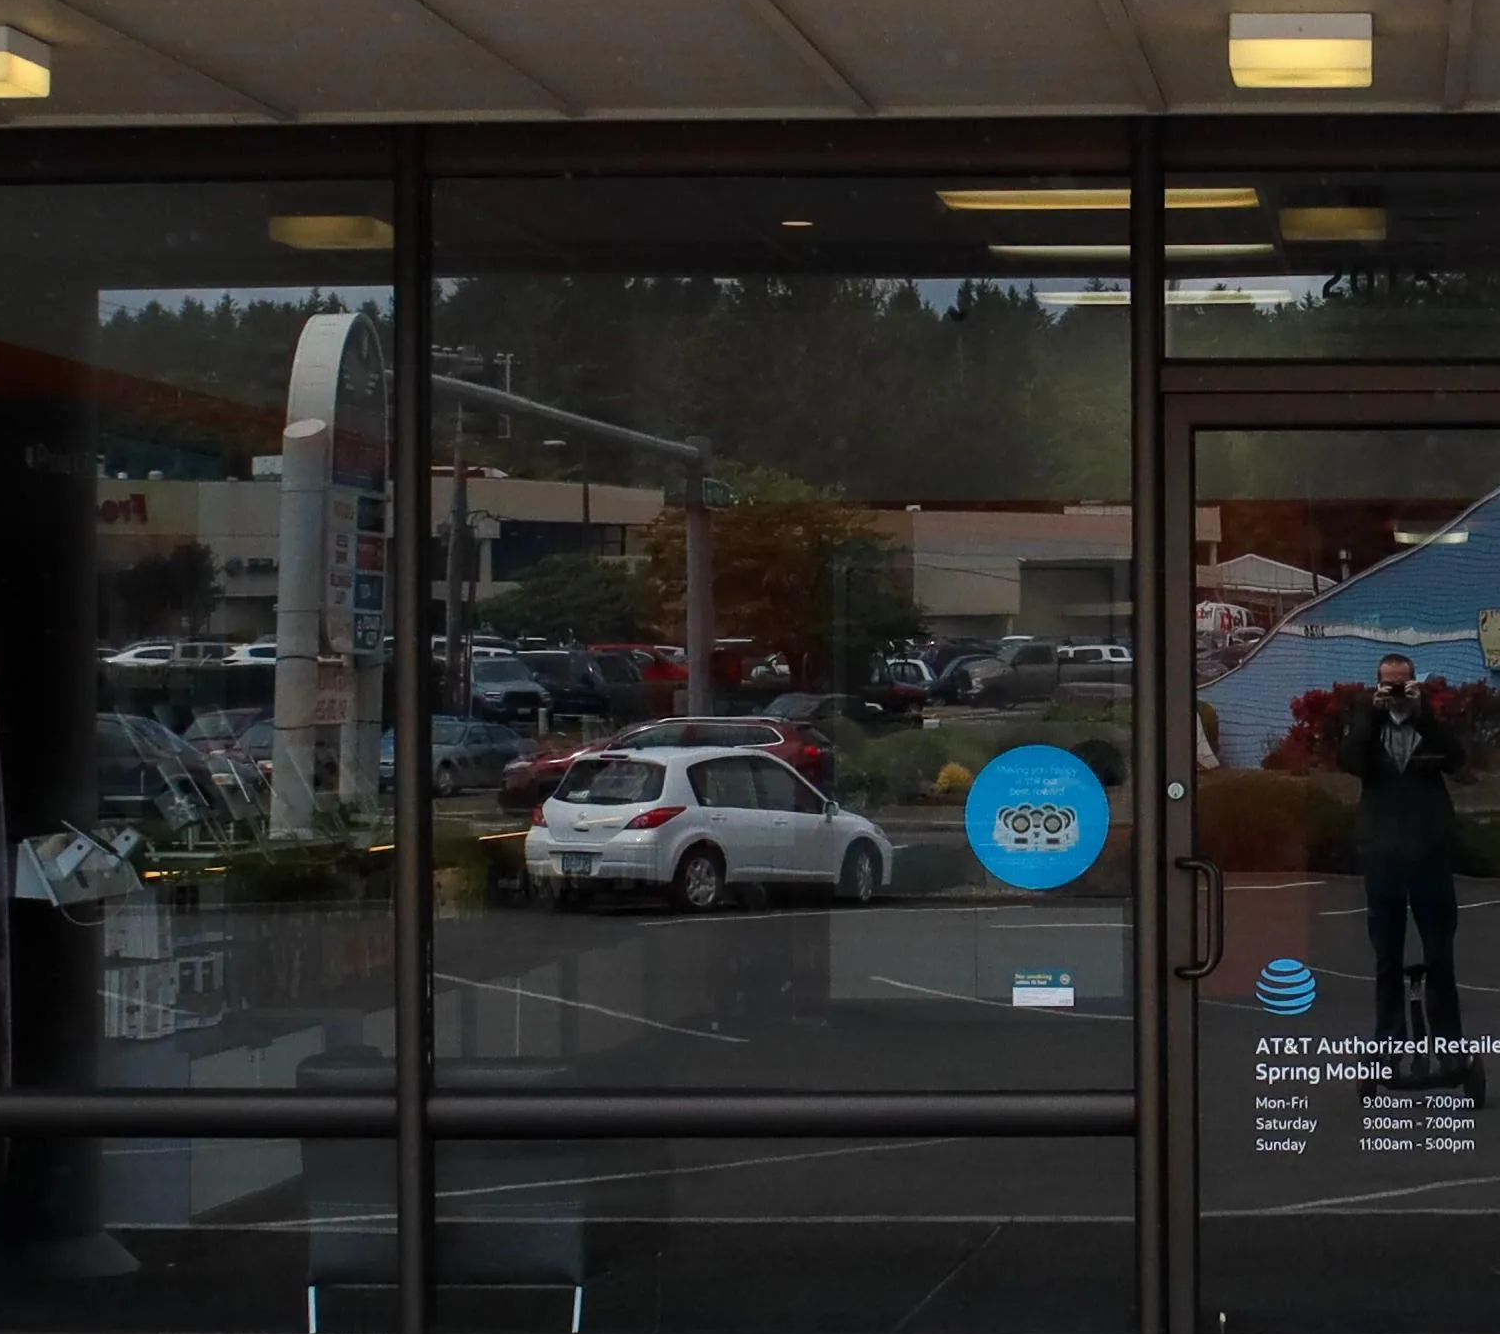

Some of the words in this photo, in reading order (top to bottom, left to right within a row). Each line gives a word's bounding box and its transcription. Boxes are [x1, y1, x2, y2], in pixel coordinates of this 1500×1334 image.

[1255, 1037, 1312, 1055] AT&T
[1316, 1035, 1429, 1055] Authorized
[1255, 1063, 1320, 1084] Spring
[1326, 1062, 1393, 1080] Mobile
[1255, 1096, 1309, 1109] Mon-Fri
[1362, 1096, 1413, 1109] 9:00am
[1425, 1096, 1475, 1113] 7:00pm
[1255, 1116, 1317, 1134] Saturday
[1363, 1117, 1413, 1130] 9:00am
[1425, 1117, 1475, 1133] 7:00pm
[1255, 1137, 1307, 1154] Sunday
[1359, 1138, 1413, 1151] 11:00am
[1425, 1138, 1475, 1154] 5:00pm
